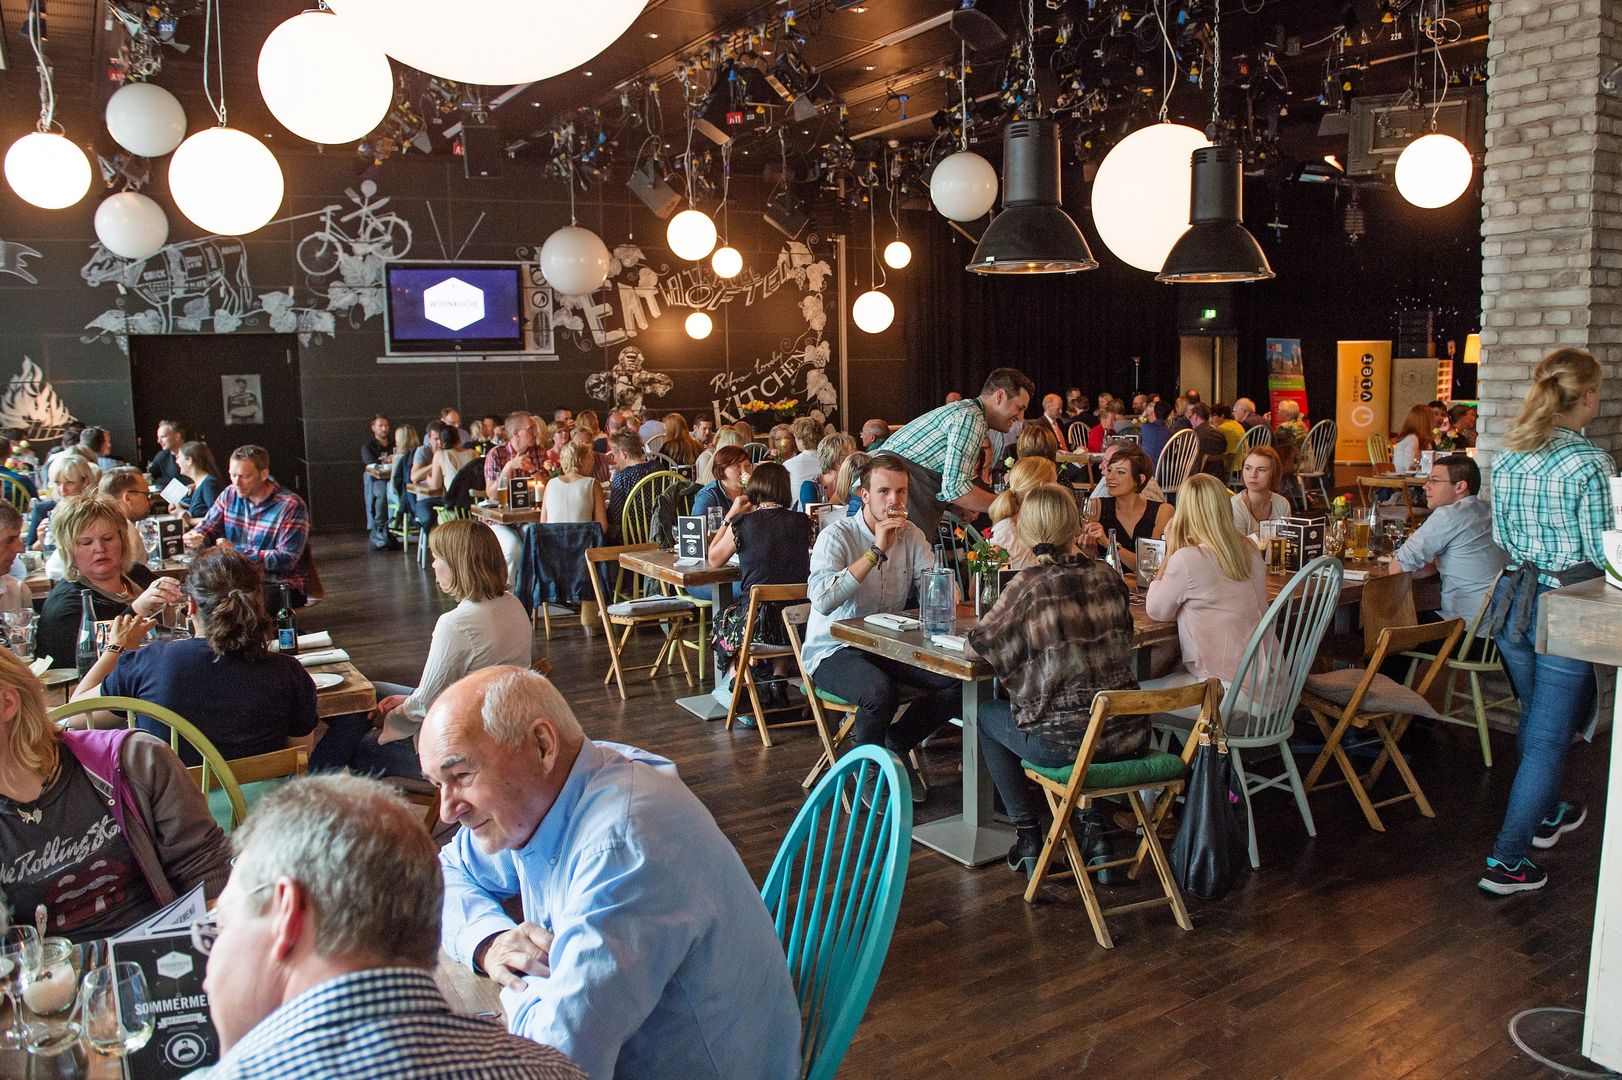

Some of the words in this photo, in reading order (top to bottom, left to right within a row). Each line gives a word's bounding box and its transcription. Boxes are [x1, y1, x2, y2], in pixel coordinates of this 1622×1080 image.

[1390, 32, 1402, 41] 228
[685, 259, 797, 311] OFTEN
[712, 350, 806, 430] KITCHEN
[1361, 353, 1374, 402] vier
[134, 994, 210, 1015] SOMMERME
